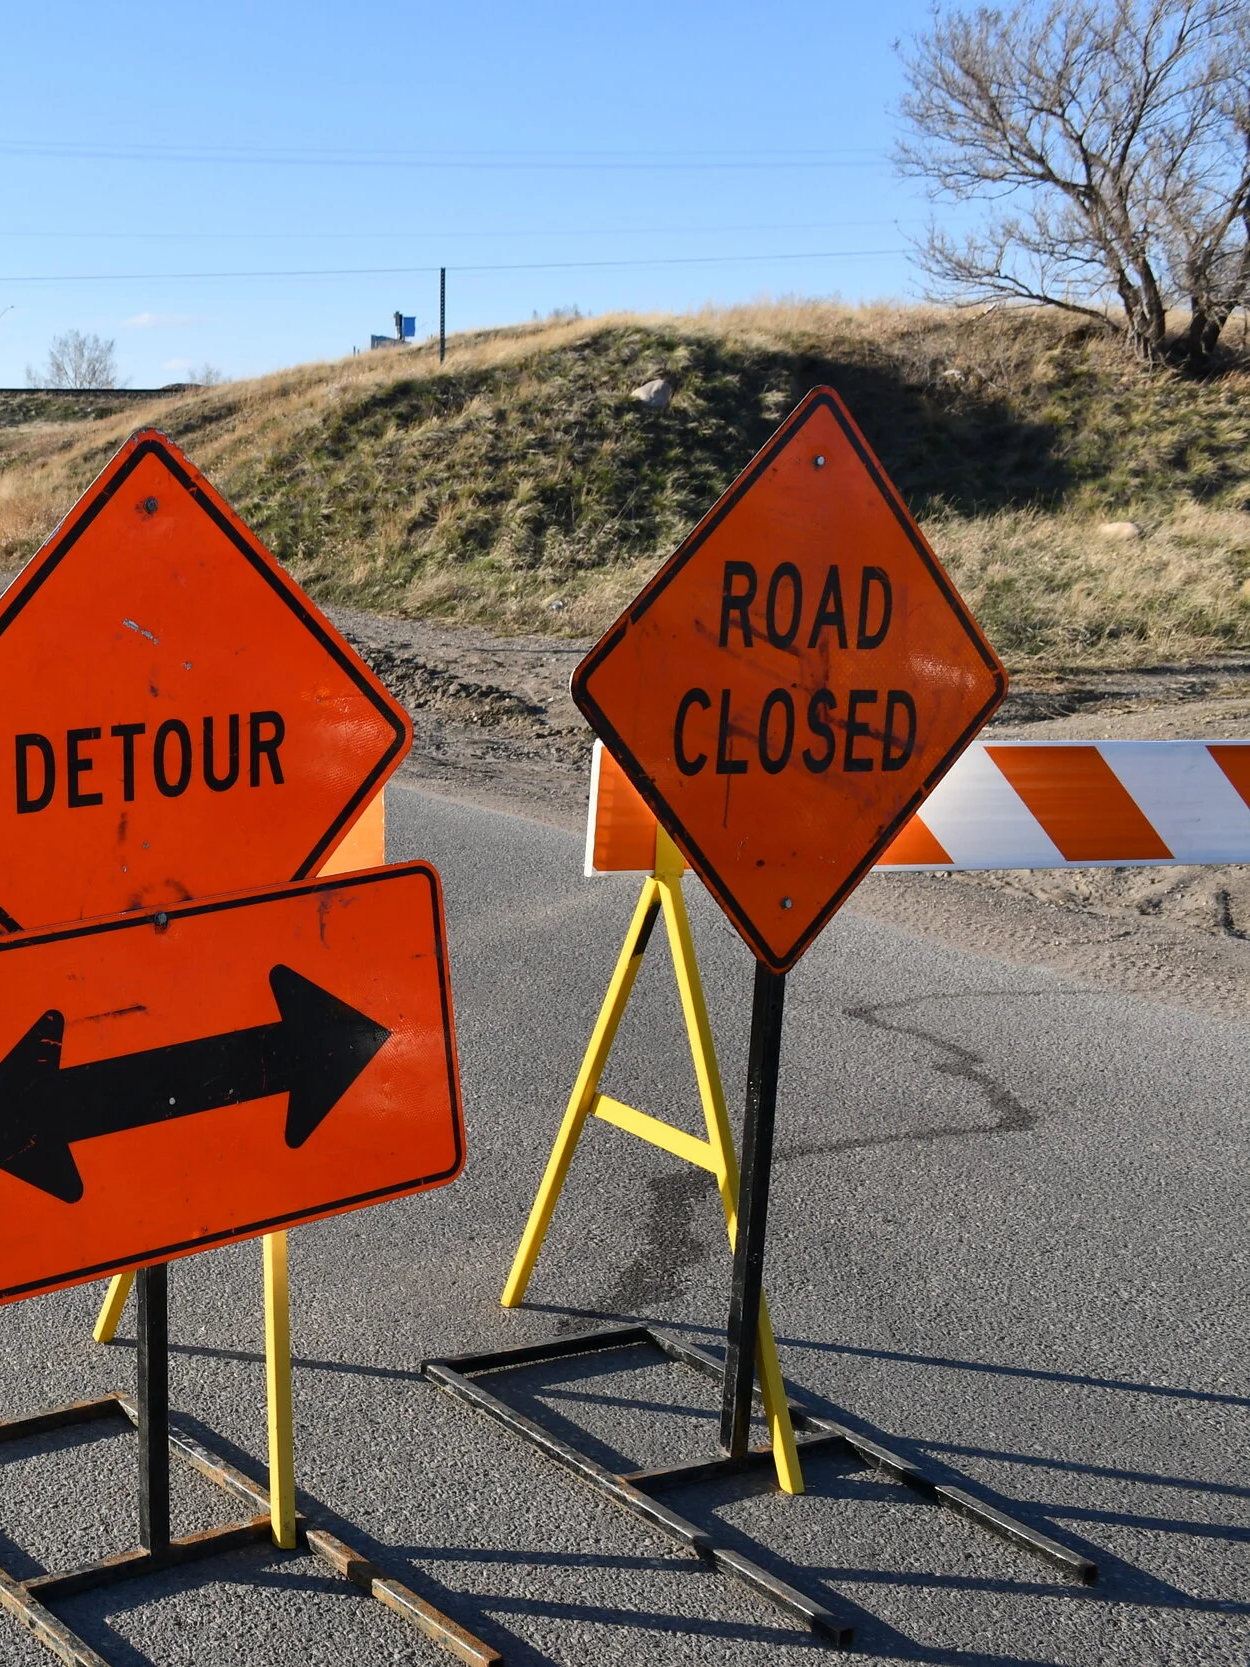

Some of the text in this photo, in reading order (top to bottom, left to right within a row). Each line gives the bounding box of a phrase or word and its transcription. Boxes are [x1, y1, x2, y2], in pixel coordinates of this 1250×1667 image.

[718, 560, 893, 650] ROAD
[15, 710, 286, 815] DETOUR
[673, 684, 917, 777] CLOSED
